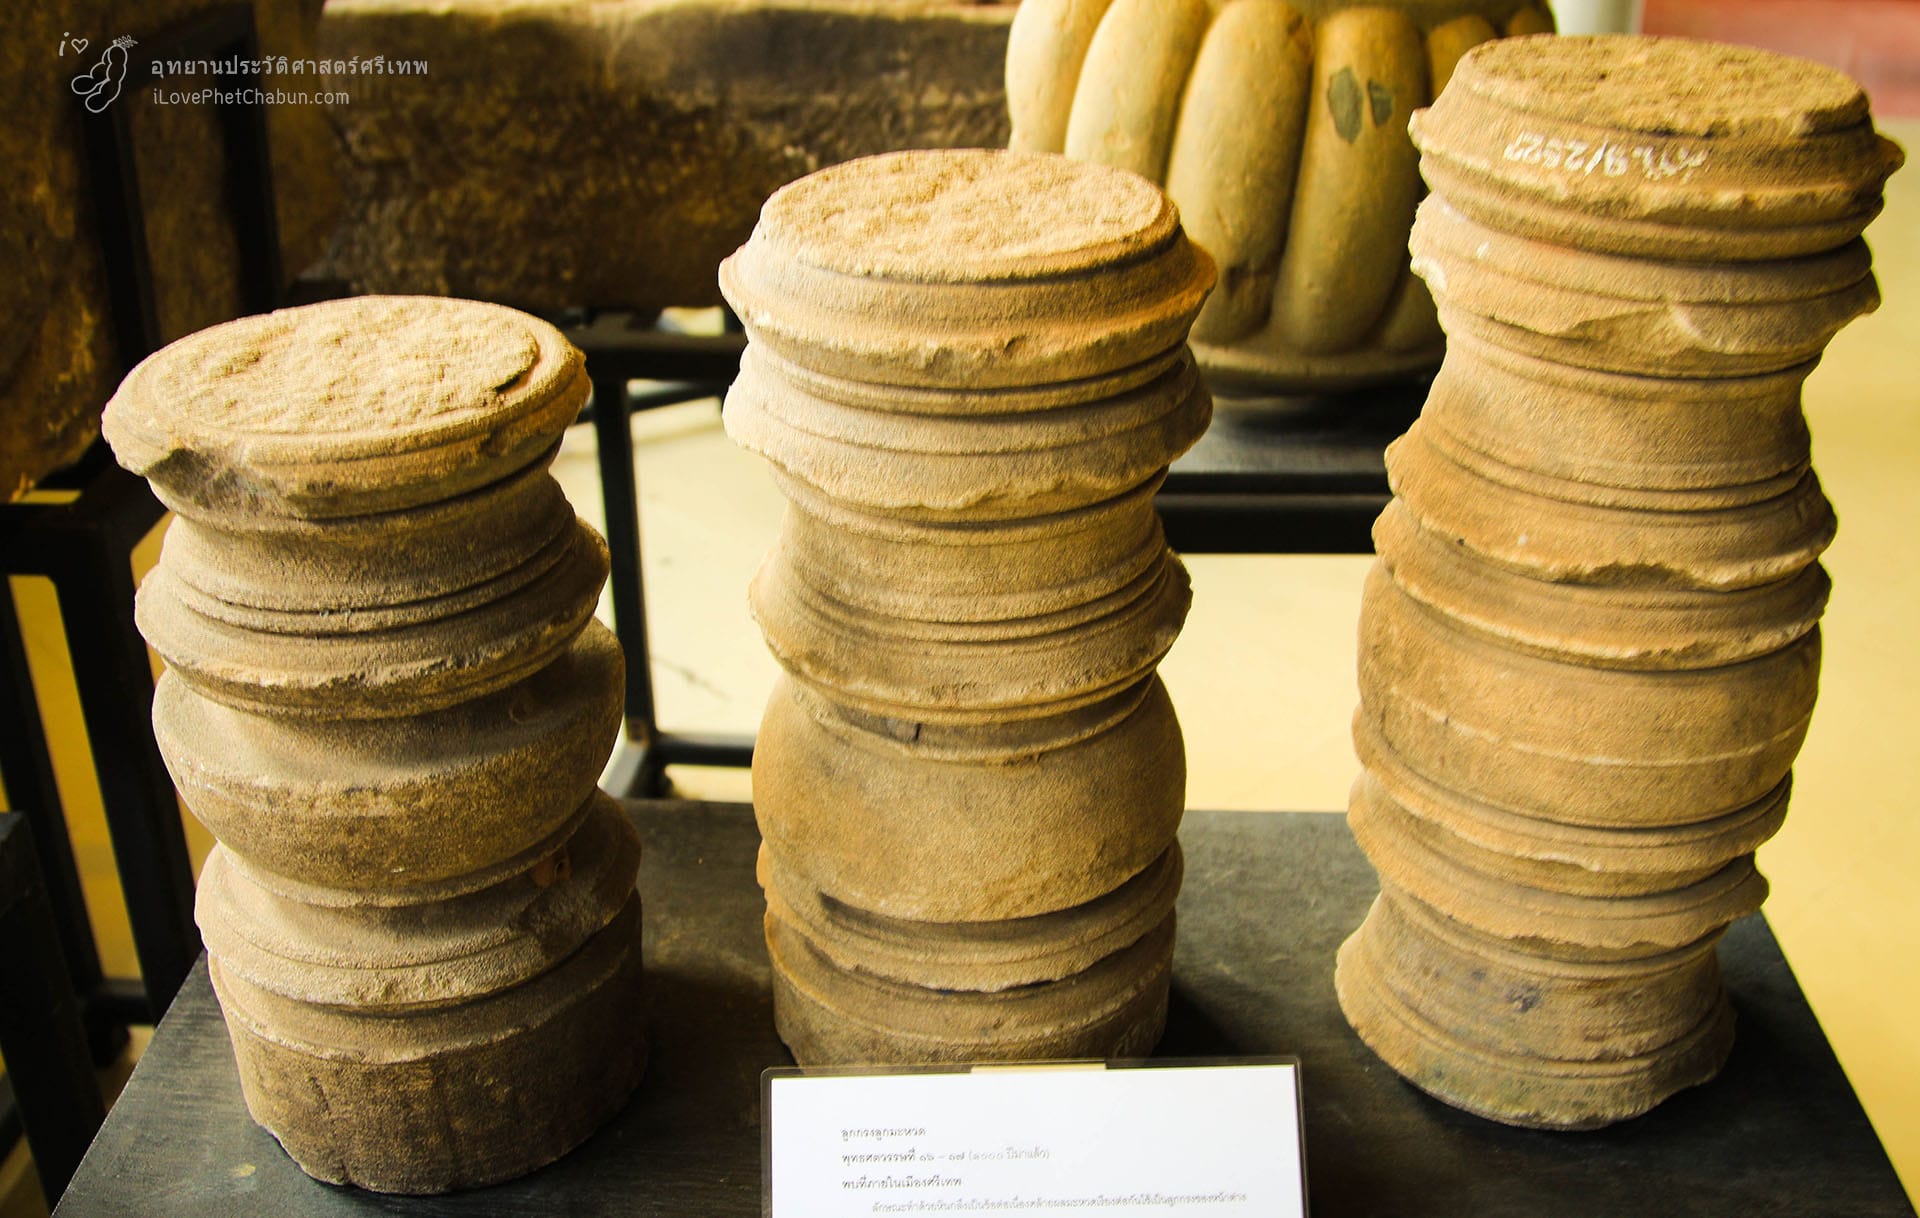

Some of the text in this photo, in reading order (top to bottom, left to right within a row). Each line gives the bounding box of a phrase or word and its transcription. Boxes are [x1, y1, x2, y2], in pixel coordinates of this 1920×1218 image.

[841, 1126, 926, 1143] ลูกกรงลูกมะหวด
[842, 1146, 916, 1168] พุทธศตวรรษที่
[842, 1173, 963, 1190] พบที่ภายในเมืองศรีเทพ
